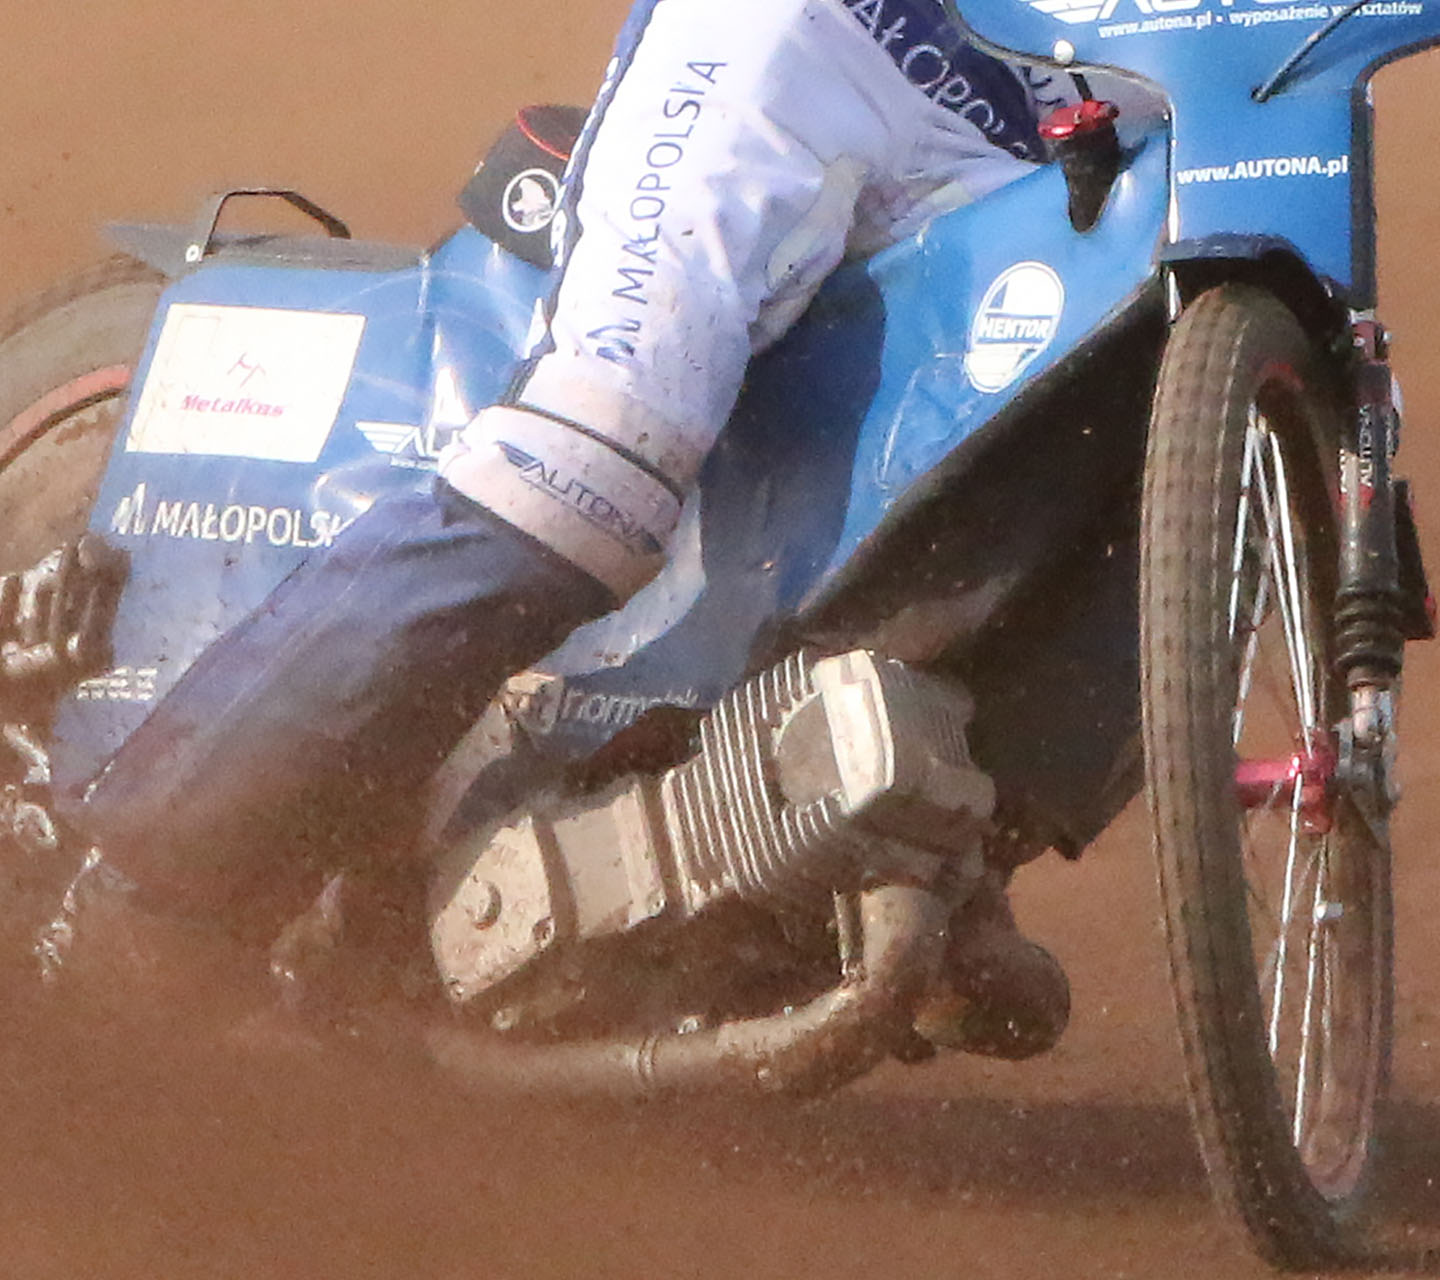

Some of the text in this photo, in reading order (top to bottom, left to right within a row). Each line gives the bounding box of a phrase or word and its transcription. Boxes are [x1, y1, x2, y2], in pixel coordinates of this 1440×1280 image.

[1098, 0, 1423, 39] www.autona.pl wyposażenie wsztatów
[1177, 155, 1349, 185] www.AUTONA.pl
[178, 394, 285, 418] Metalkas
[152, 499, 356, 549] MAŁOPOLSK
